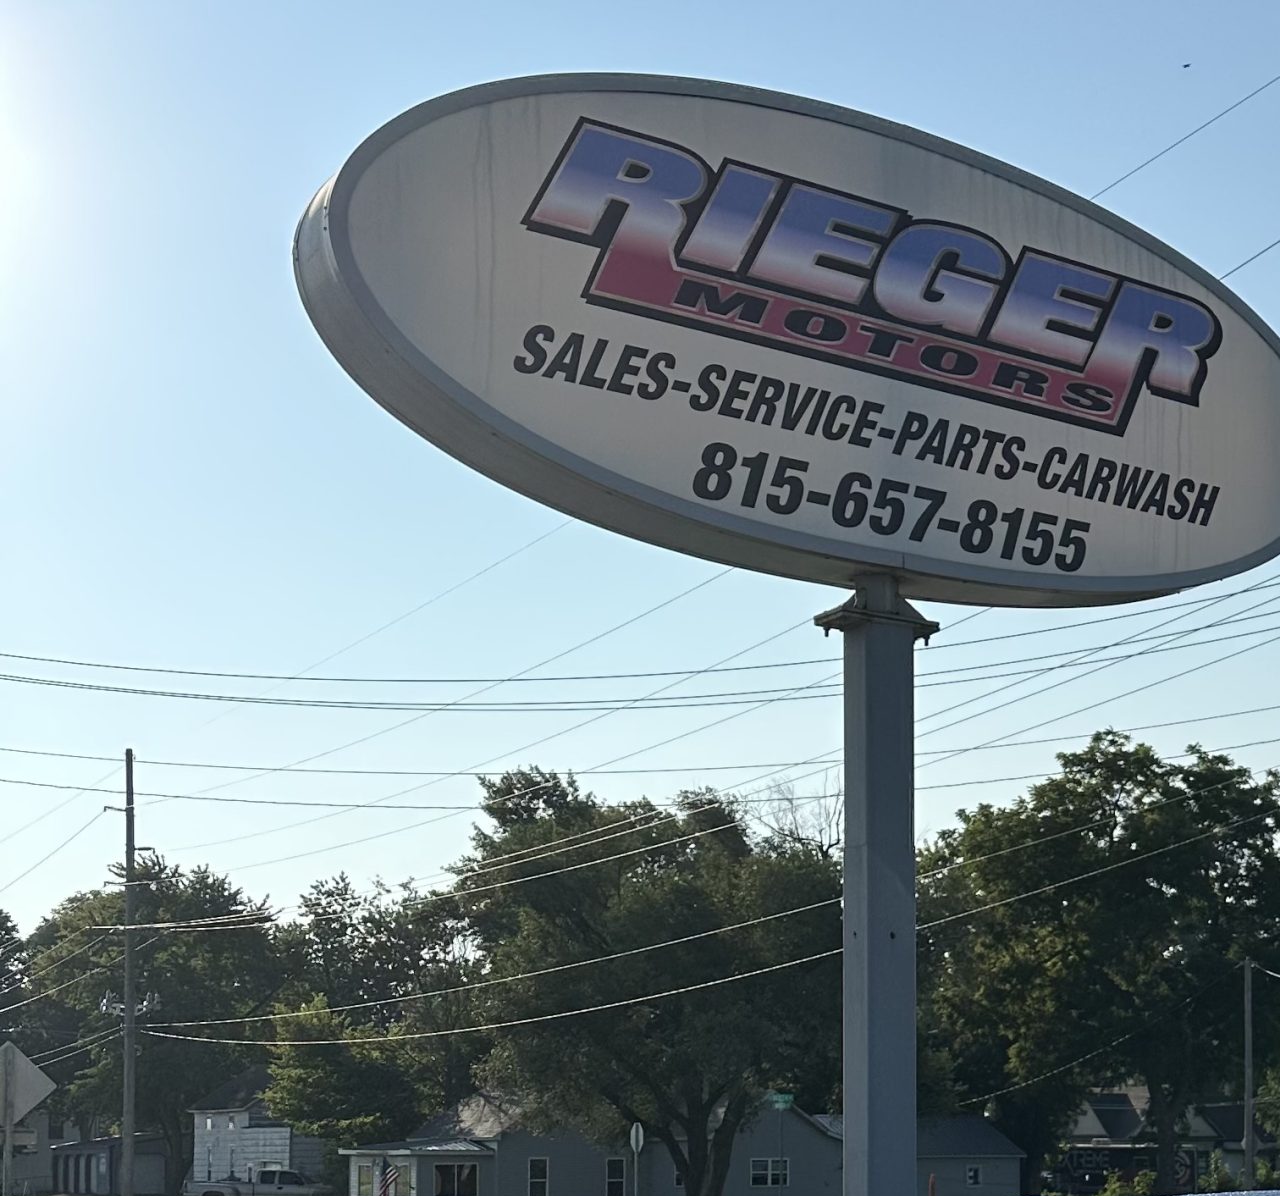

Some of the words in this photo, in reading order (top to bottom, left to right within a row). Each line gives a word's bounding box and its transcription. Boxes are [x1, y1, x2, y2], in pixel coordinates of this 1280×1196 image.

[521, 116, 1223, 407] RIEGER
[671, 278, 1115, 413] MOTORS
[513, 324, 1220, 527] SALES-SERVICE-PARTS-CARWASH
[692, 442, 1091, 572] 815-657-8155
